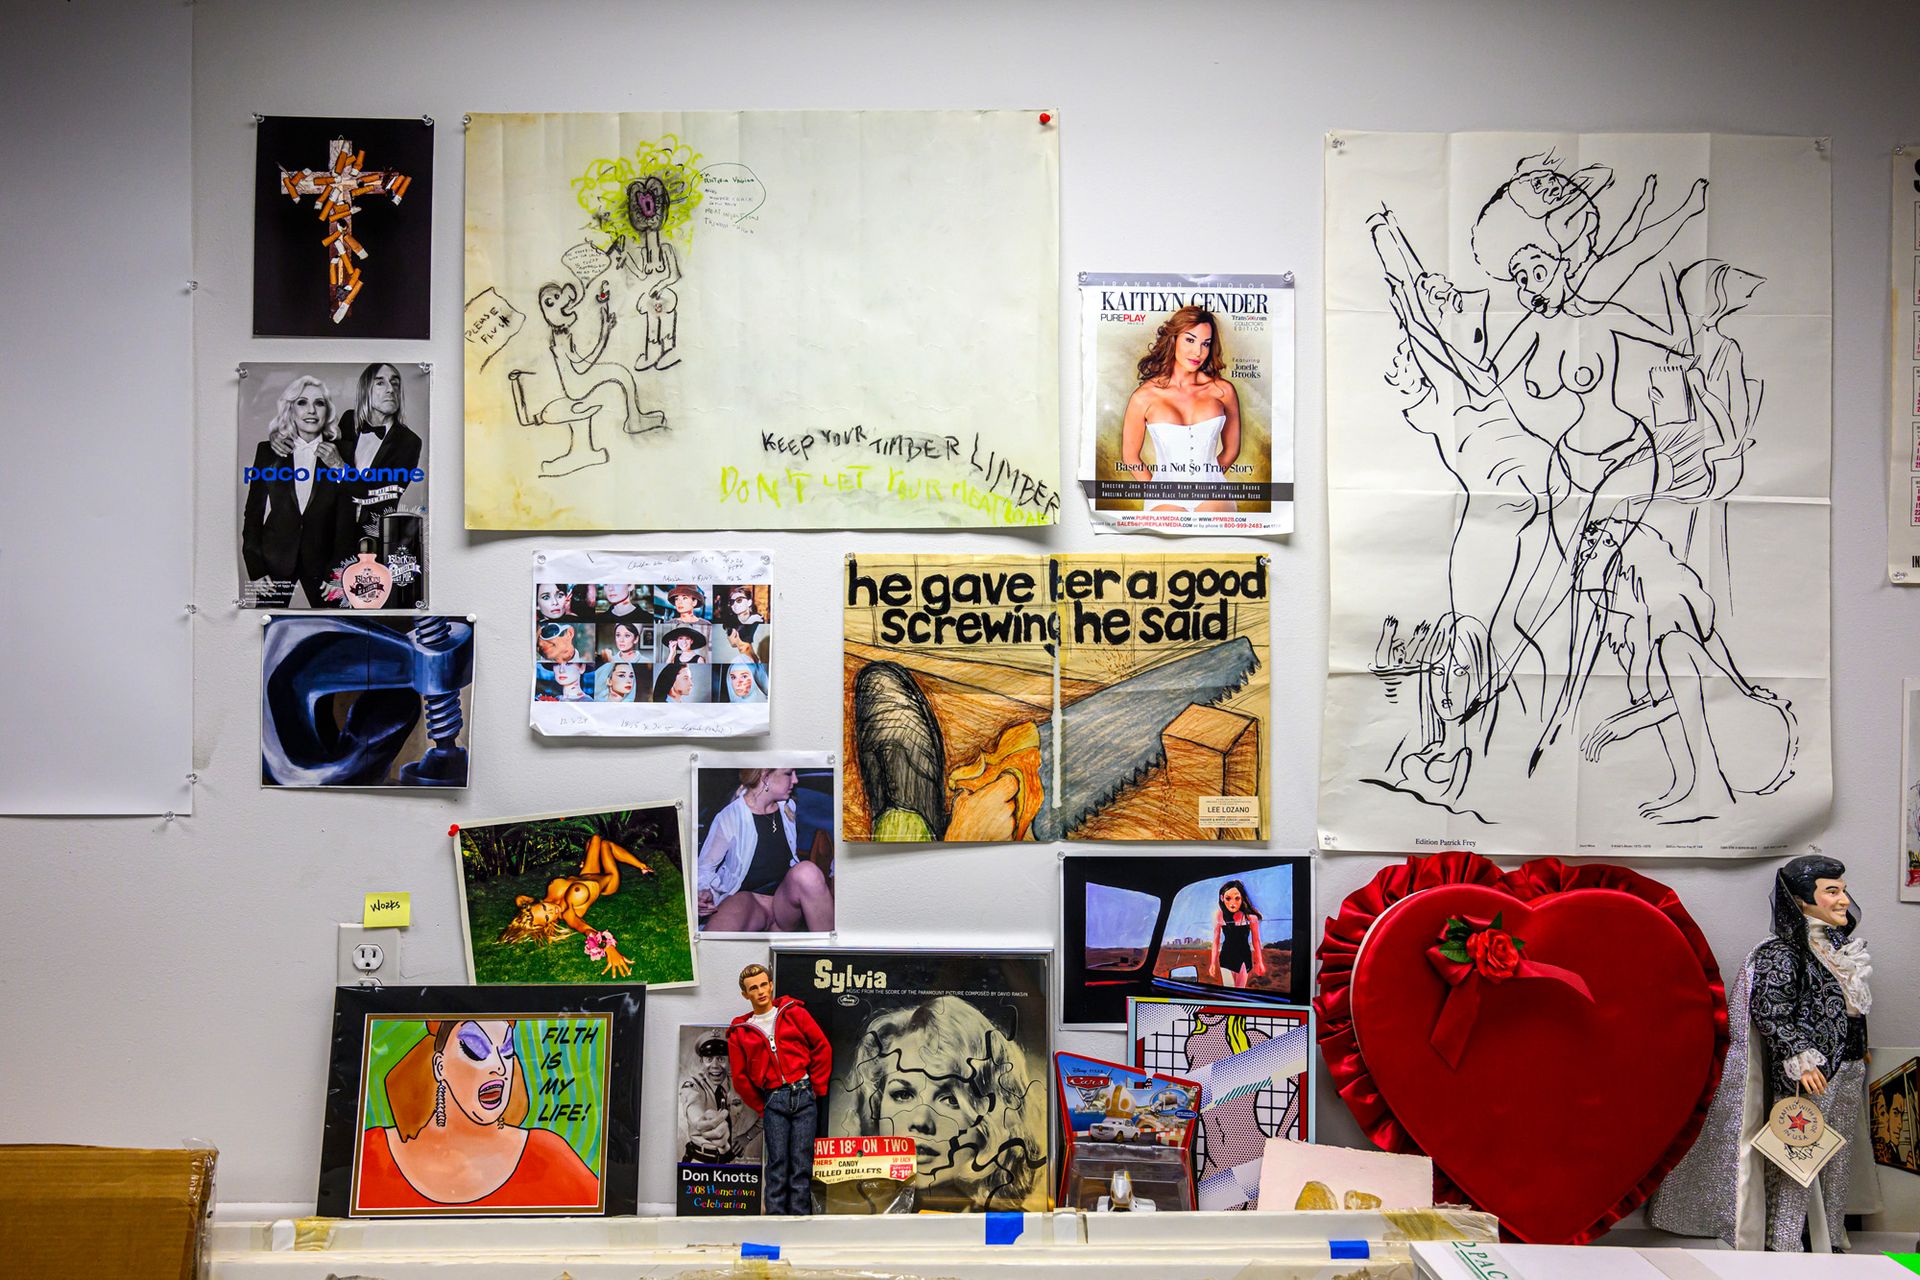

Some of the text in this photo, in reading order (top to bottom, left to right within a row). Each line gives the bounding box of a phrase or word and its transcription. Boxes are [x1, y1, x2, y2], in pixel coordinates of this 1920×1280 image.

[1101, 291, 1269, 314] KAITLYN GENDER
[464, 306, 499, 343] PLEASE
[1100, 314, 1146, 322] PUREPLAY
[1231, 370, 1261, 379] Brooks
[243, 464, 425, 484] paco rabanne
[761, 425, 1061, 525] KEEP YOUR TIMBER LIMBER
[1115, 462, 1144, 472] Based
[1147, 464, 1158, 472] on
[1169, 463, 1186, 472] Not
[1189, 463, 1201, 473] So
[1203, 463, 1227, 473] True
[1229, 463, 1255, 475] Story
[823, 465, 873, 490] LET
[887, 465, 944, 502] YOUR
[848, 559, 912, 607] he
[921, 572, 1036, 616] gave
[1126, 570, 1158, 600] a
[1168, 556, 1266, 611] good
[881, 598, 1228, 658] screwing he said
[1415, 838, 1477, 847] Edition Patrick Frey
[813, 958, 887, 994] Sylvia
[541, 1026, 599, 1044] FILTH
[540, 1052, 562, 1070] IS
[539, 1077, 575, 1095] MY
[537, 1103, 592, 1122] LIFE!
[1778, 1104, 1797, 1125] CRAFTED
[862, 1139, 878, 1153] ON
[884, 1138, 909, 1152] TWO
[814, 1167, 882, 1178] FILLED BULLETS
[838, 1160, 859, 1168] CANDY
[682, 1169, 759, 1183] Don Knotts
[686, 1183, 756, 1197] 2008 Hometown
[693, 1197, 747, 1209] Celebration
